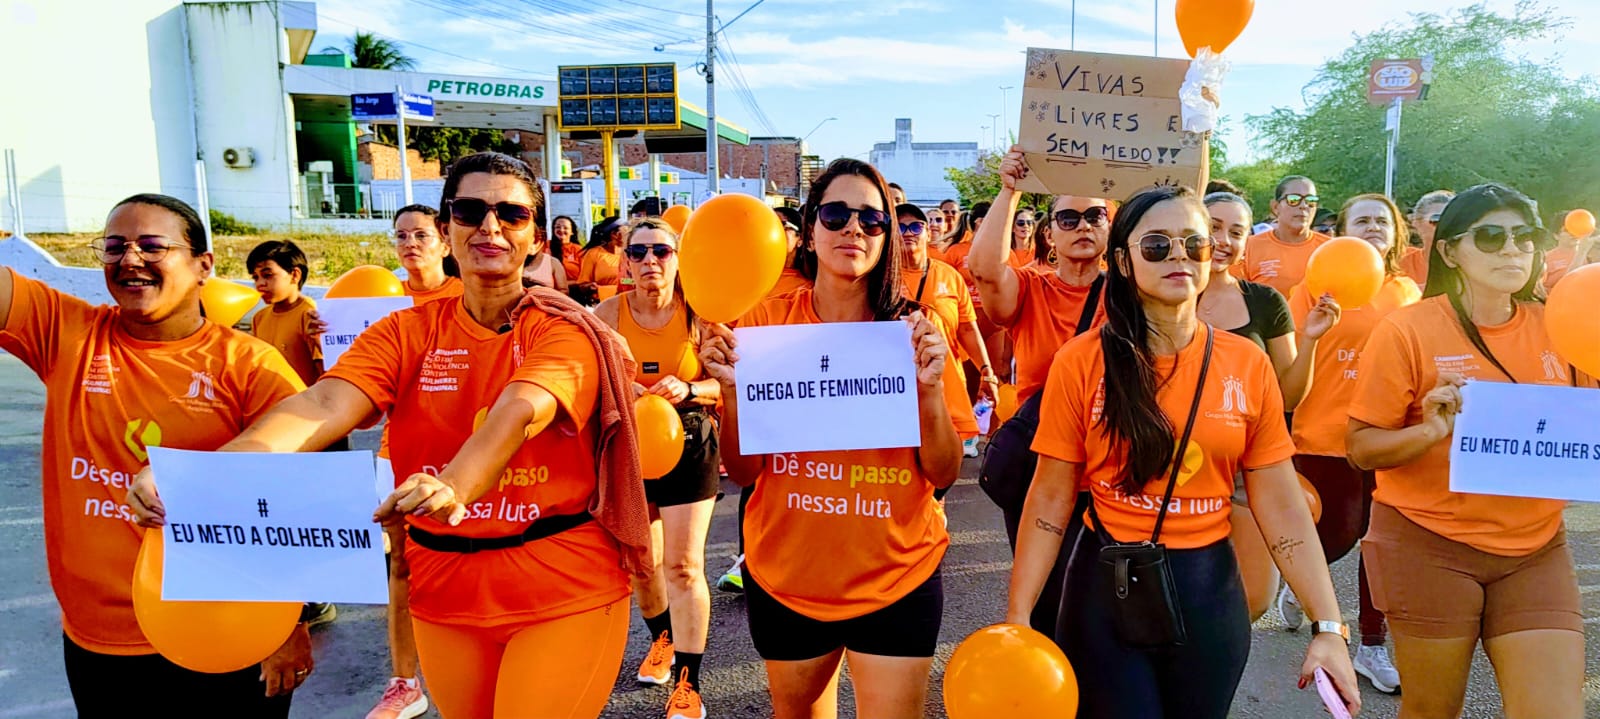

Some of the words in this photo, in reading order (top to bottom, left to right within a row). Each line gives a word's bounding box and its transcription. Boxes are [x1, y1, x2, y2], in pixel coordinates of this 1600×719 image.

[427, 79, 545, 99] PETROBRAS
[1055, 62, 1144, 96] VIVAS
[1168, 115, 1179, 132] E
[1046, 133, 1088, 157] SEM
[324, 335, 335, 345] EU
[820, 355, 830, 372] #
[747, 381, 794, 402] CHEGA
[798, 381, 816, 399] DE
[820, 373, 905, 397] FEMINICÍDIO
[1536, 419, 1546, 434] #
[1460, 436, 1478, 452] EU
[1481, 438, 1518, 455] METO
[1522, 440, 1531, 456] A
[1535, 441, 1589, 459] COLHER
[773, 454, 799, 476] Dê
[805, 461, 843, 481] seu
[850, 464, 912, 488] passo
[257, 498, 269, 518] #
[498, 496, 541, 523] luta
[788, 492, 848, 515] nessa
[855, 493, 892, 518] luta
[171, 523, 195, 544] EU
[197, 524, 246, 545] METO
[251, 526, 263, 546] A
[265, 526, 334, 548] COLHER
[337, 528, 372, 549] SIM
